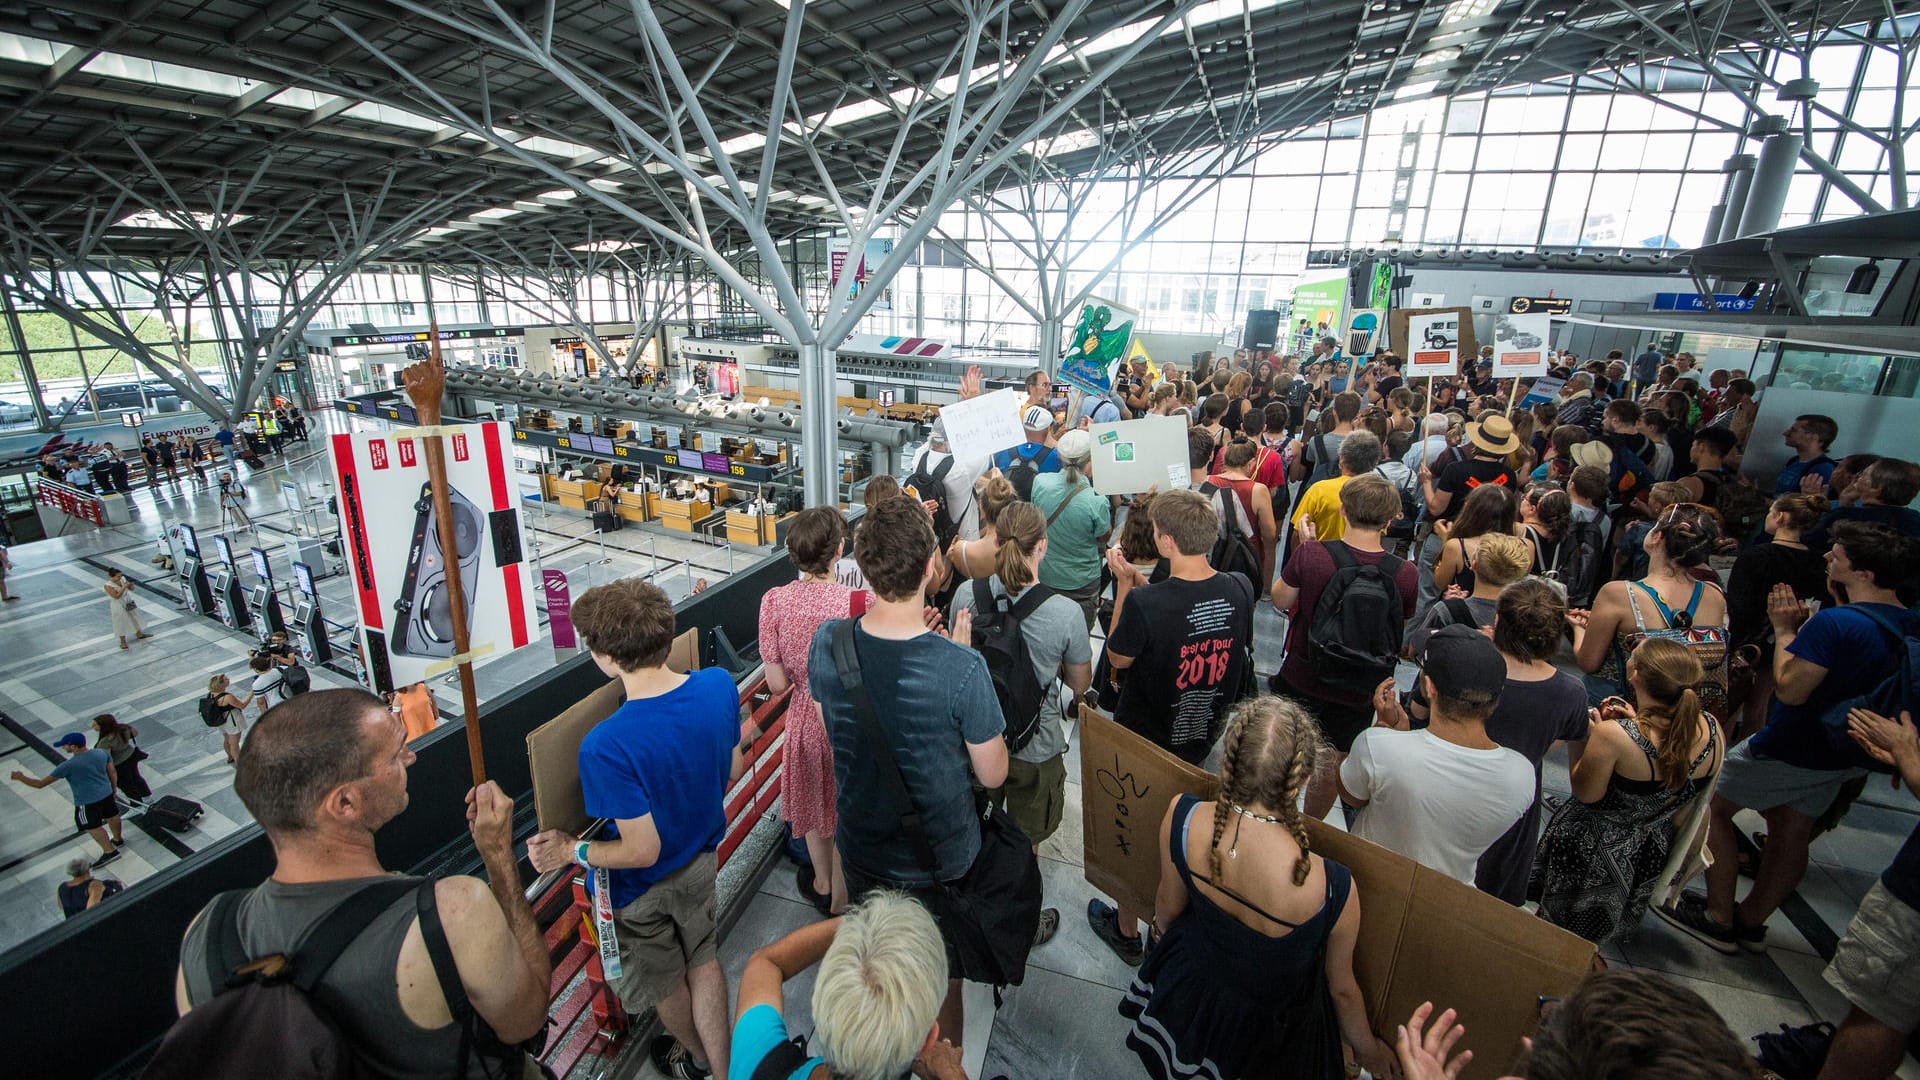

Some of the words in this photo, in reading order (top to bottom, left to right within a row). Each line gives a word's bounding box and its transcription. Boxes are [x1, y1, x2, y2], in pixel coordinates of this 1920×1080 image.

[142, 425, 210, 441] Eurowings
[515, 431, 527, 440] 154
[557, 437, 570, 447] 155
[614, 447, 627, 456] 156
[663, 454, 677, 464] 157
[730, 465, 744, 475] 158
[1180, 641, 1199, 658] Best
[1200, 639, 1210, 653] of
[1211, 638, 1234, 651] Tour
[1175, 650, 1230, 690] 2018
